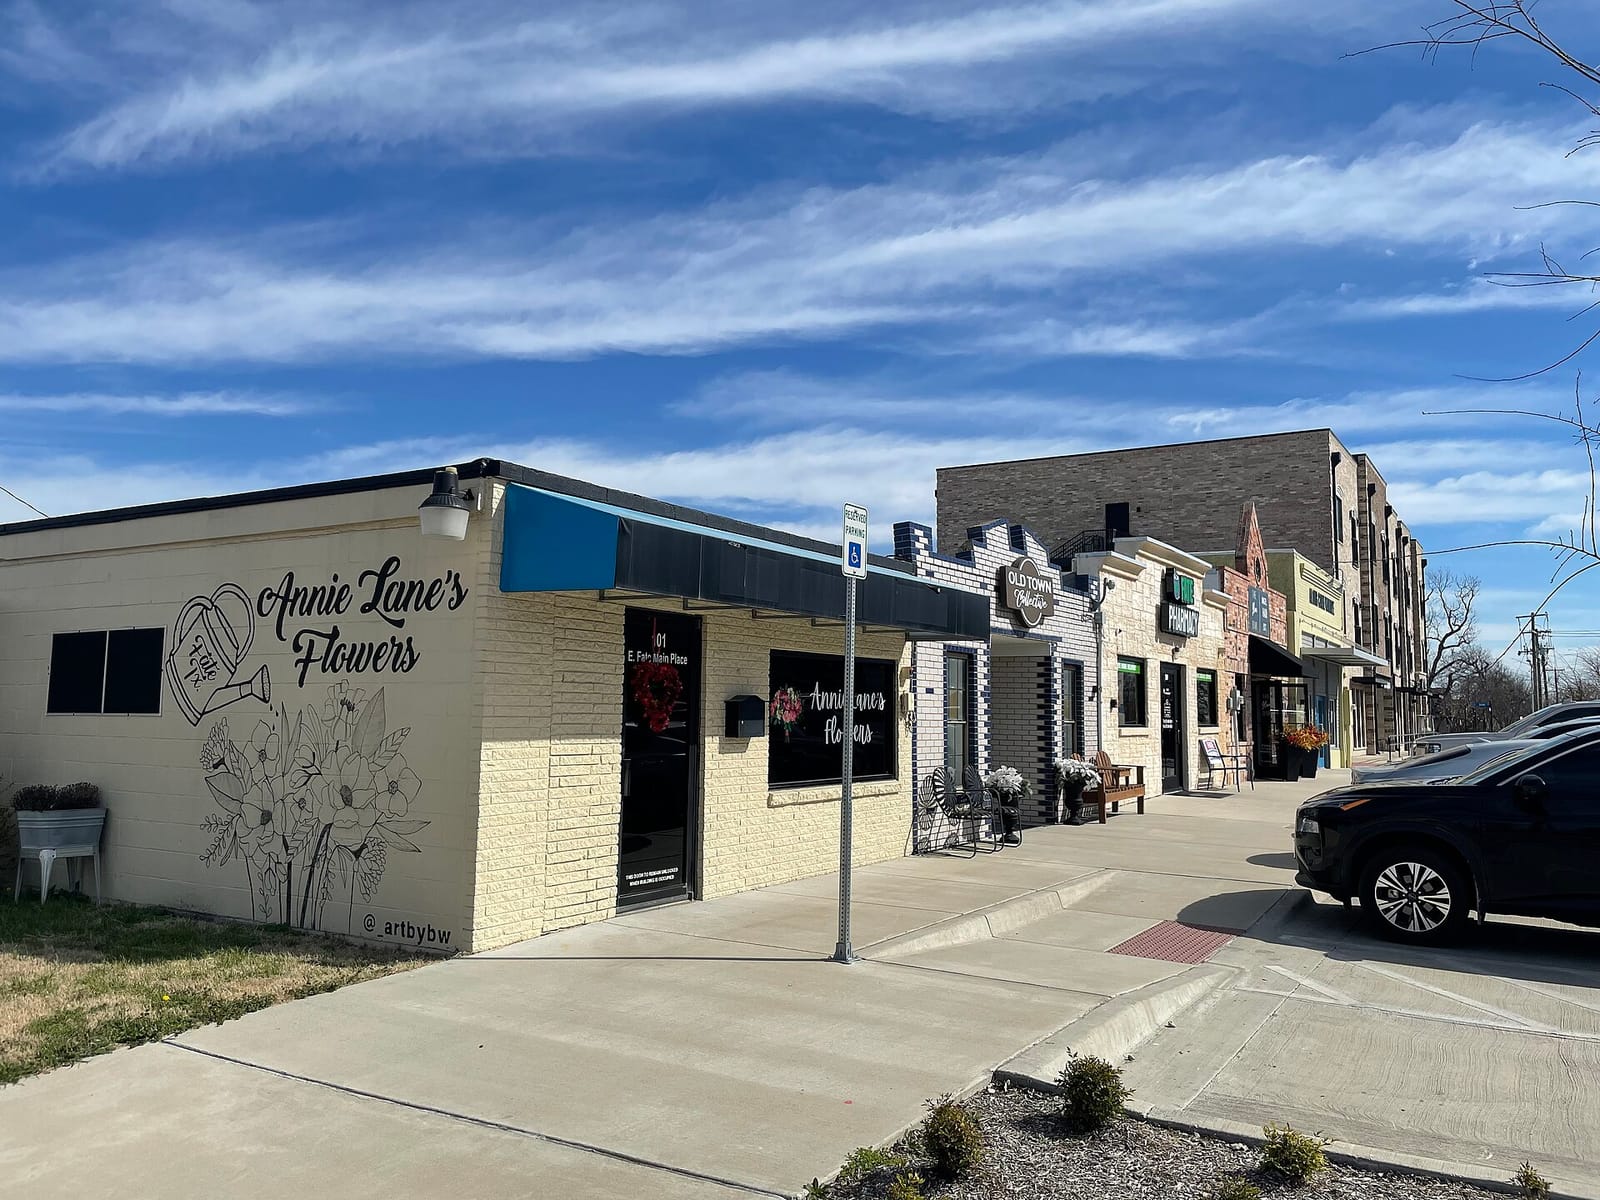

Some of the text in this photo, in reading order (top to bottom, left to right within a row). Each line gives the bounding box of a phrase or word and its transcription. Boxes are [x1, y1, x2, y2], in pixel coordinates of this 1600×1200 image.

[845, 509, 867, 524] RESERVED
[845, 525, 866, 539] PARKING
[1008, 571, 1052, 594] OLD TOWN
[257, 556, 469, 642] Annie Lane's
[1014, 589, 1049, 609] Collective
[1168, 604, 1199, 635] PHARMACY
[292, 625, 421, 688] Flowers
[627, 650, 635, 662] E.
[652, 652, 669, 664] Main
[670, 652, 688, 665] Place
[853, 691, 886, 712] ane's
[824, 715, 874, 745] Floers
[363, 913, 451, 945] @_artbybw
